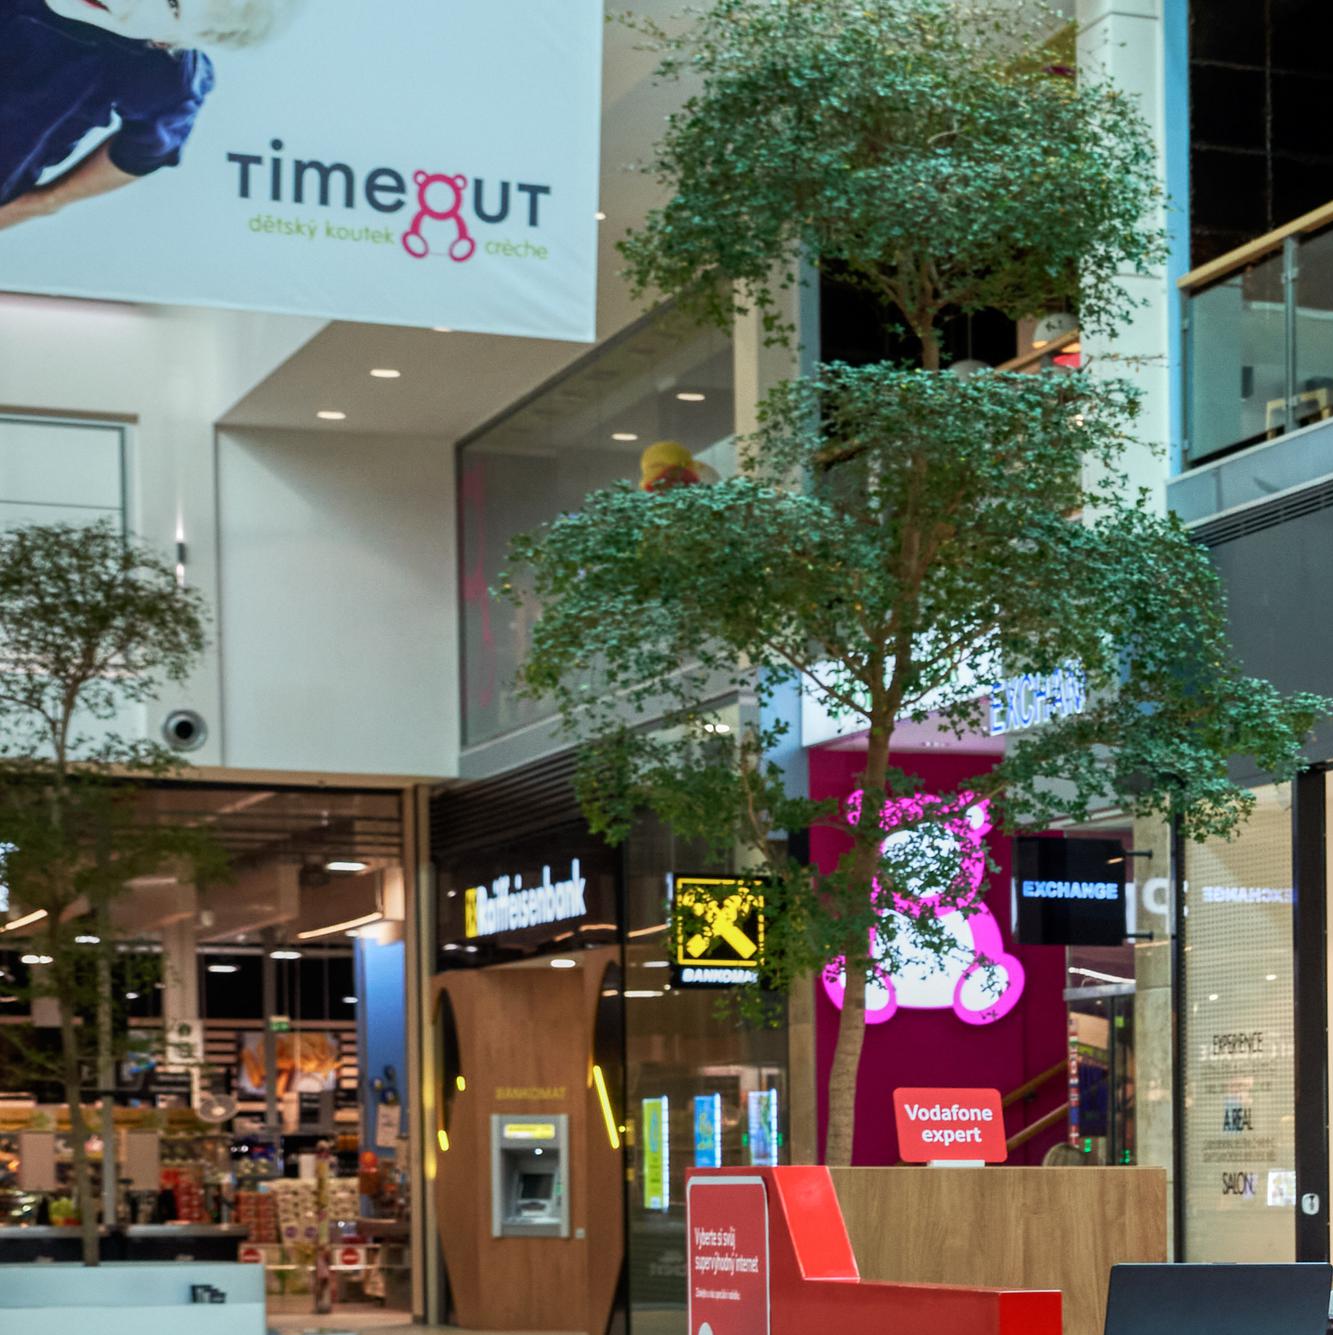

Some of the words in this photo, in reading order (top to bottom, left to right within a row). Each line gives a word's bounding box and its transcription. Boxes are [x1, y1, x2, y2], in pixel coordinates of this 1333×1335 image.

[249, 214, 318, 240] dětský
[325, 220, 396, 244] koutek
[1022, 880, 1119, 900] EXCHANGE
[903, 1103, 994, 1122] Vodafone
[921, 1126, 983, 1147] expert
[1222, 1171, 1255, 1196] SALON
[694, 1226, 717, 1250] Vyberte
